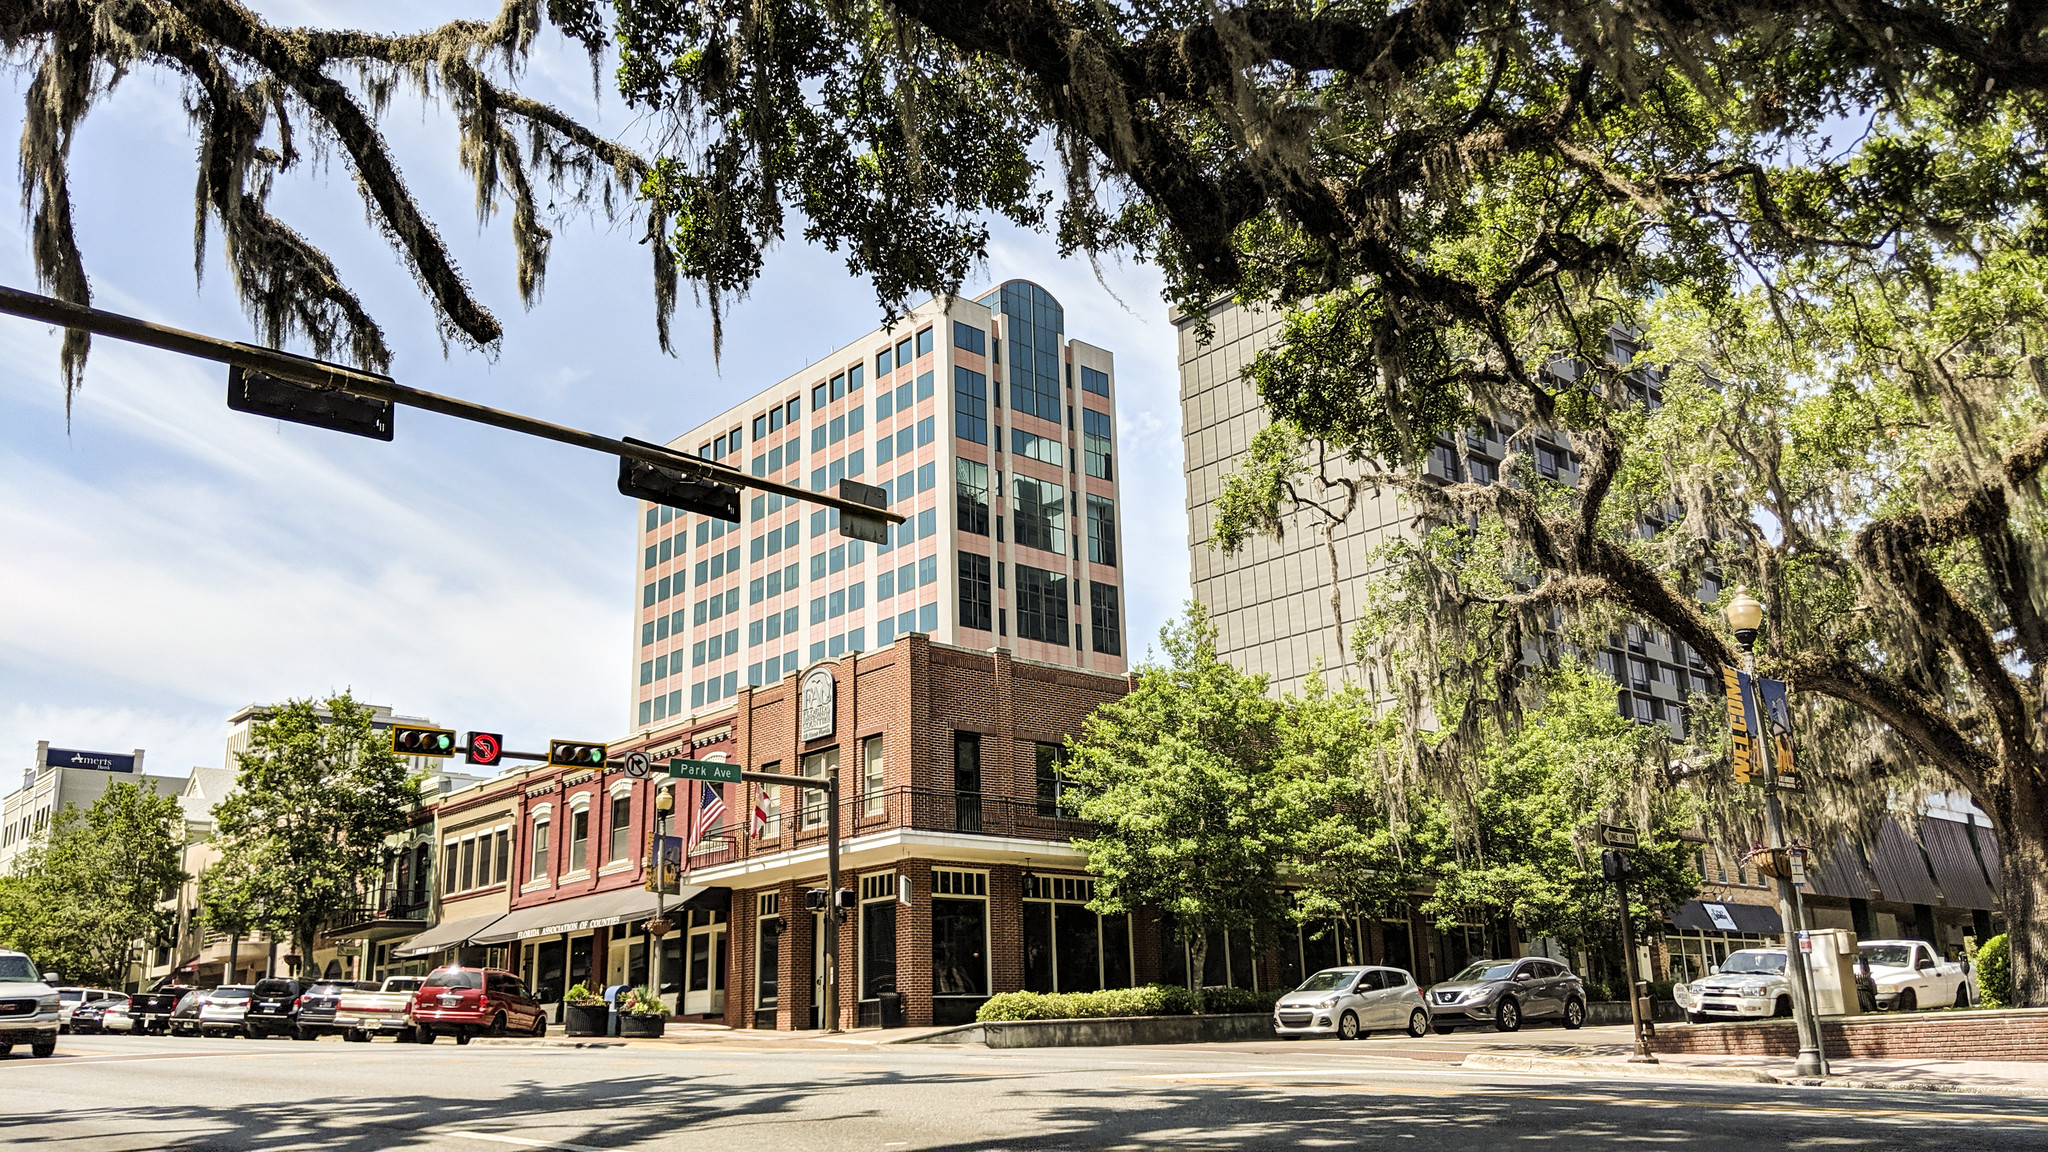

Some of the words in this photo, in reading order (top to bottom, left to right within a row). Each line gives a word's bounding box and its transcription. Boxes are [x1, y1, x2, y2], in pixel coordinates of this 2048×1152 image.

[1722, 665, 1750, 783] WELCOME
[681, 763, 707, 776] Park
[713, 767, 731, 778] Ave
[1609, 832, 1619, 840] ONE
[1621, 834, 1634, 843] WAY
[517, 931, 540, 940] FLORIDA
[541, 922, 578, 936] ASSOCIATION
[580, 920, 588, 929] OF
[589, 916, 621, 929] COUNTIES
